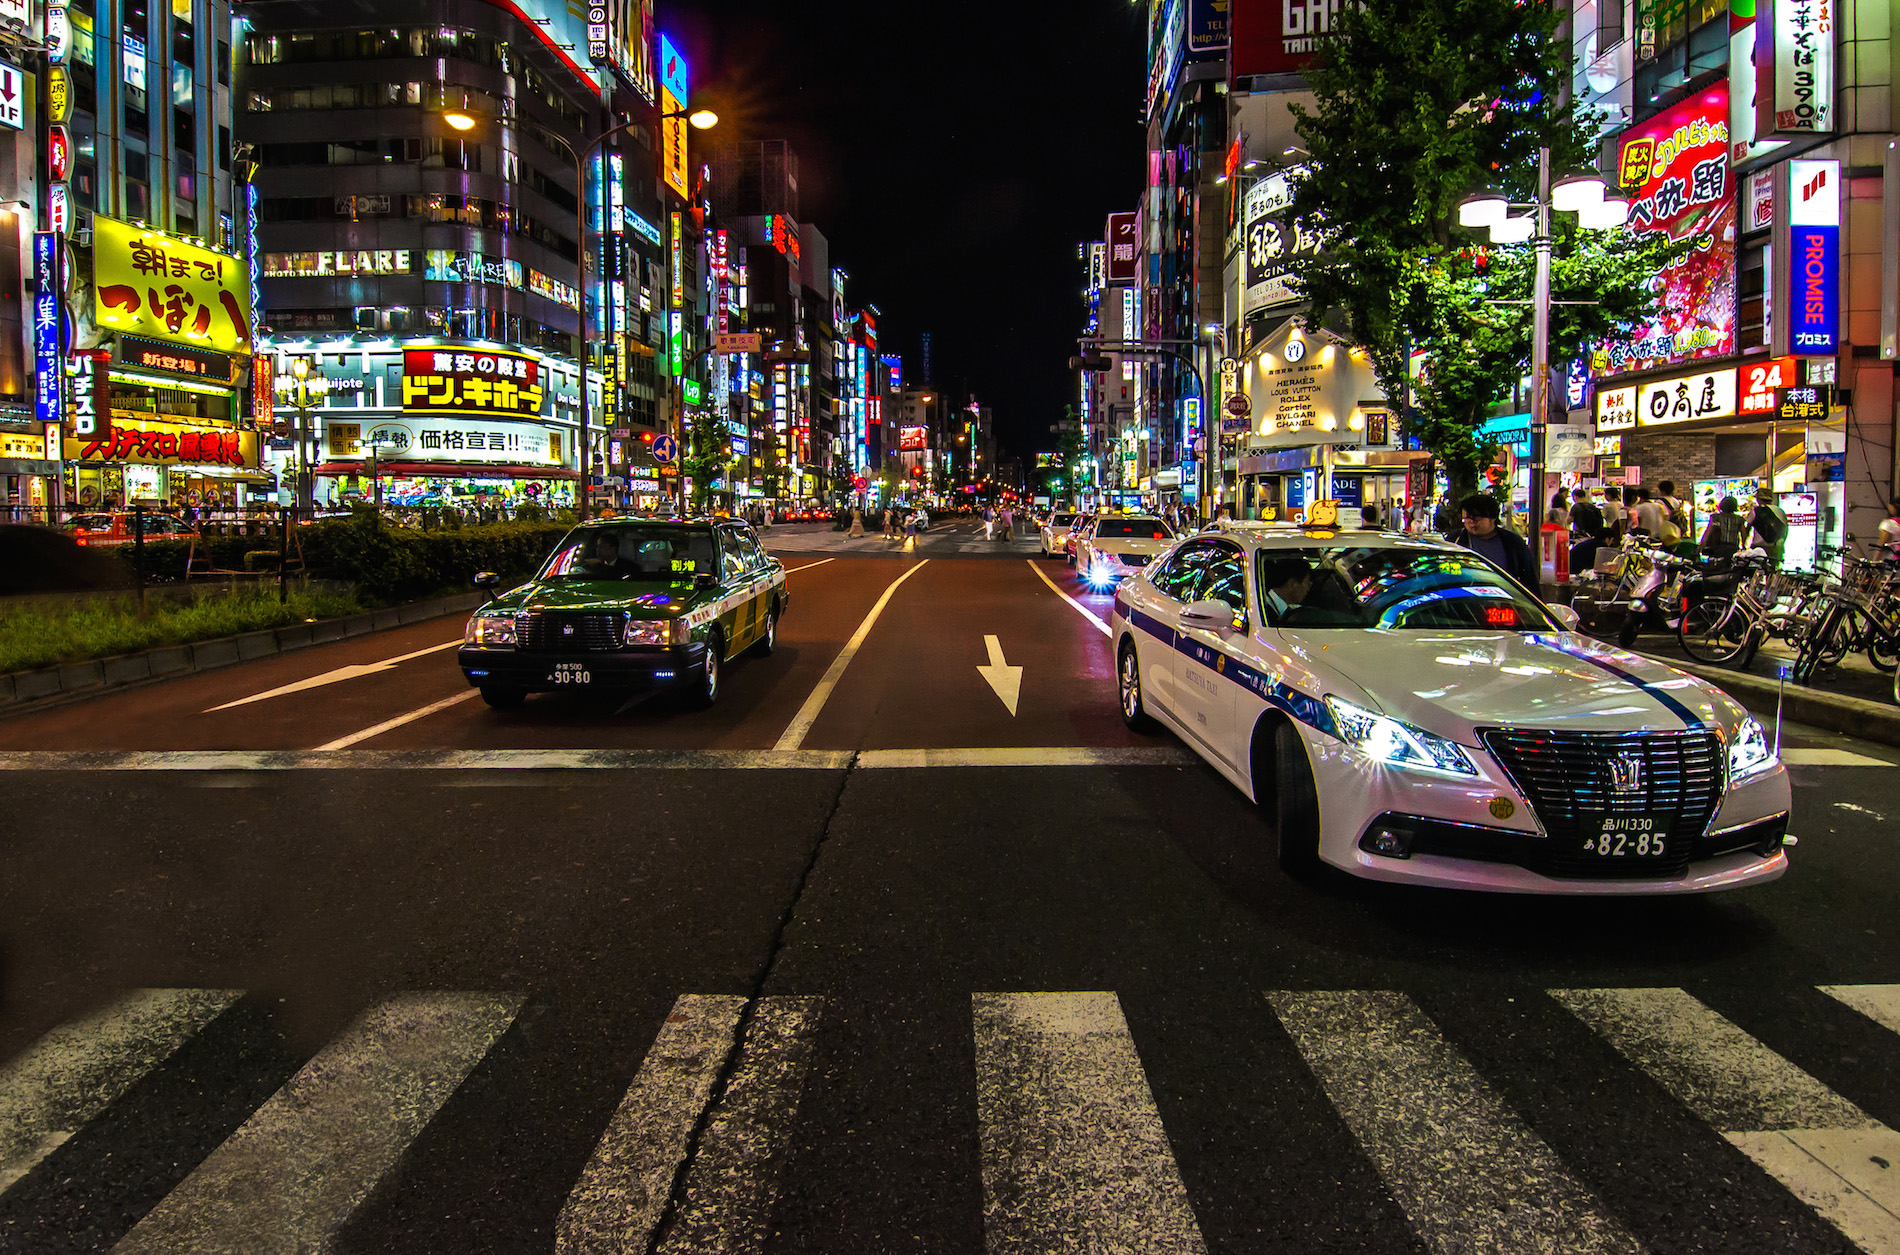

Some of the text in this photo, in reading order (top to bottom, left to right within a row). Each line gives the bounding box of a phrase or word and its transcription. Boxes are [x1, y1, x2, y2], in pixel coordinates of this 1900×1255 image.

[588, 0, 606, 58] の聖地
[1207, 21, 1224, 30] TEL
[52, 83, 65, 111] 虎の子
[1653, 120, 1729, 175] カルビちゃん
[1120, 224, 1136, 235] ク
[719, 235, 728, 278] カラオケ
[1113, 244, 1133, 261] 龍
[129, 241, 223, 286] 朝まで!
[317, 250, 410, 271] FLARE
[299, 269, 335, 277] STUDIO
[1805, 235, 1824, 324] PROMISE
[552, 280, 580, 312] FLA
[97, 284, 249, 342] つぼ八
[1796, 334, 1831, 346] プロミス
[1609, 335, 1673, 367] 食べ放題
[433, 352, 527, 378] 驚安の殿堂
[328, 378, 363, 391] uijote
[1750, 365, 1782, 394] 24
[65, 354, 96, 434] パチスロ
[1270, 385, 1321, 396] LOUIS VUITTON
[1650, 376, 1721, 419] 日高屋
[1787, 388, 1816, 403] 本格
[1280, 394, 1311, 403] ROLEX
[1279, 403, 1312, 412] Cartier
[1781, 402, 1824, 417] 台湾式
[1276, 411, 1316, 420] BVLGARI
[1276, 420, 1314, 428] CHANEL
[332, 427, 358, 438] 情熱
[373, 429, 408, 449] 情熱
[420, 429, 519, 451] 価格宣言!!
[332, 440, 358, 453] 価格
[1550, 444, 1592, 455] タクシー
[1550, 457, 1591, 470] のりば
[483, 472, 509, 480] Quijote
[671, 559, 695, 571] 割増
[555, 671, 590, 683] 90-80
[1583, 833, 1666, 856] あ 82-85
